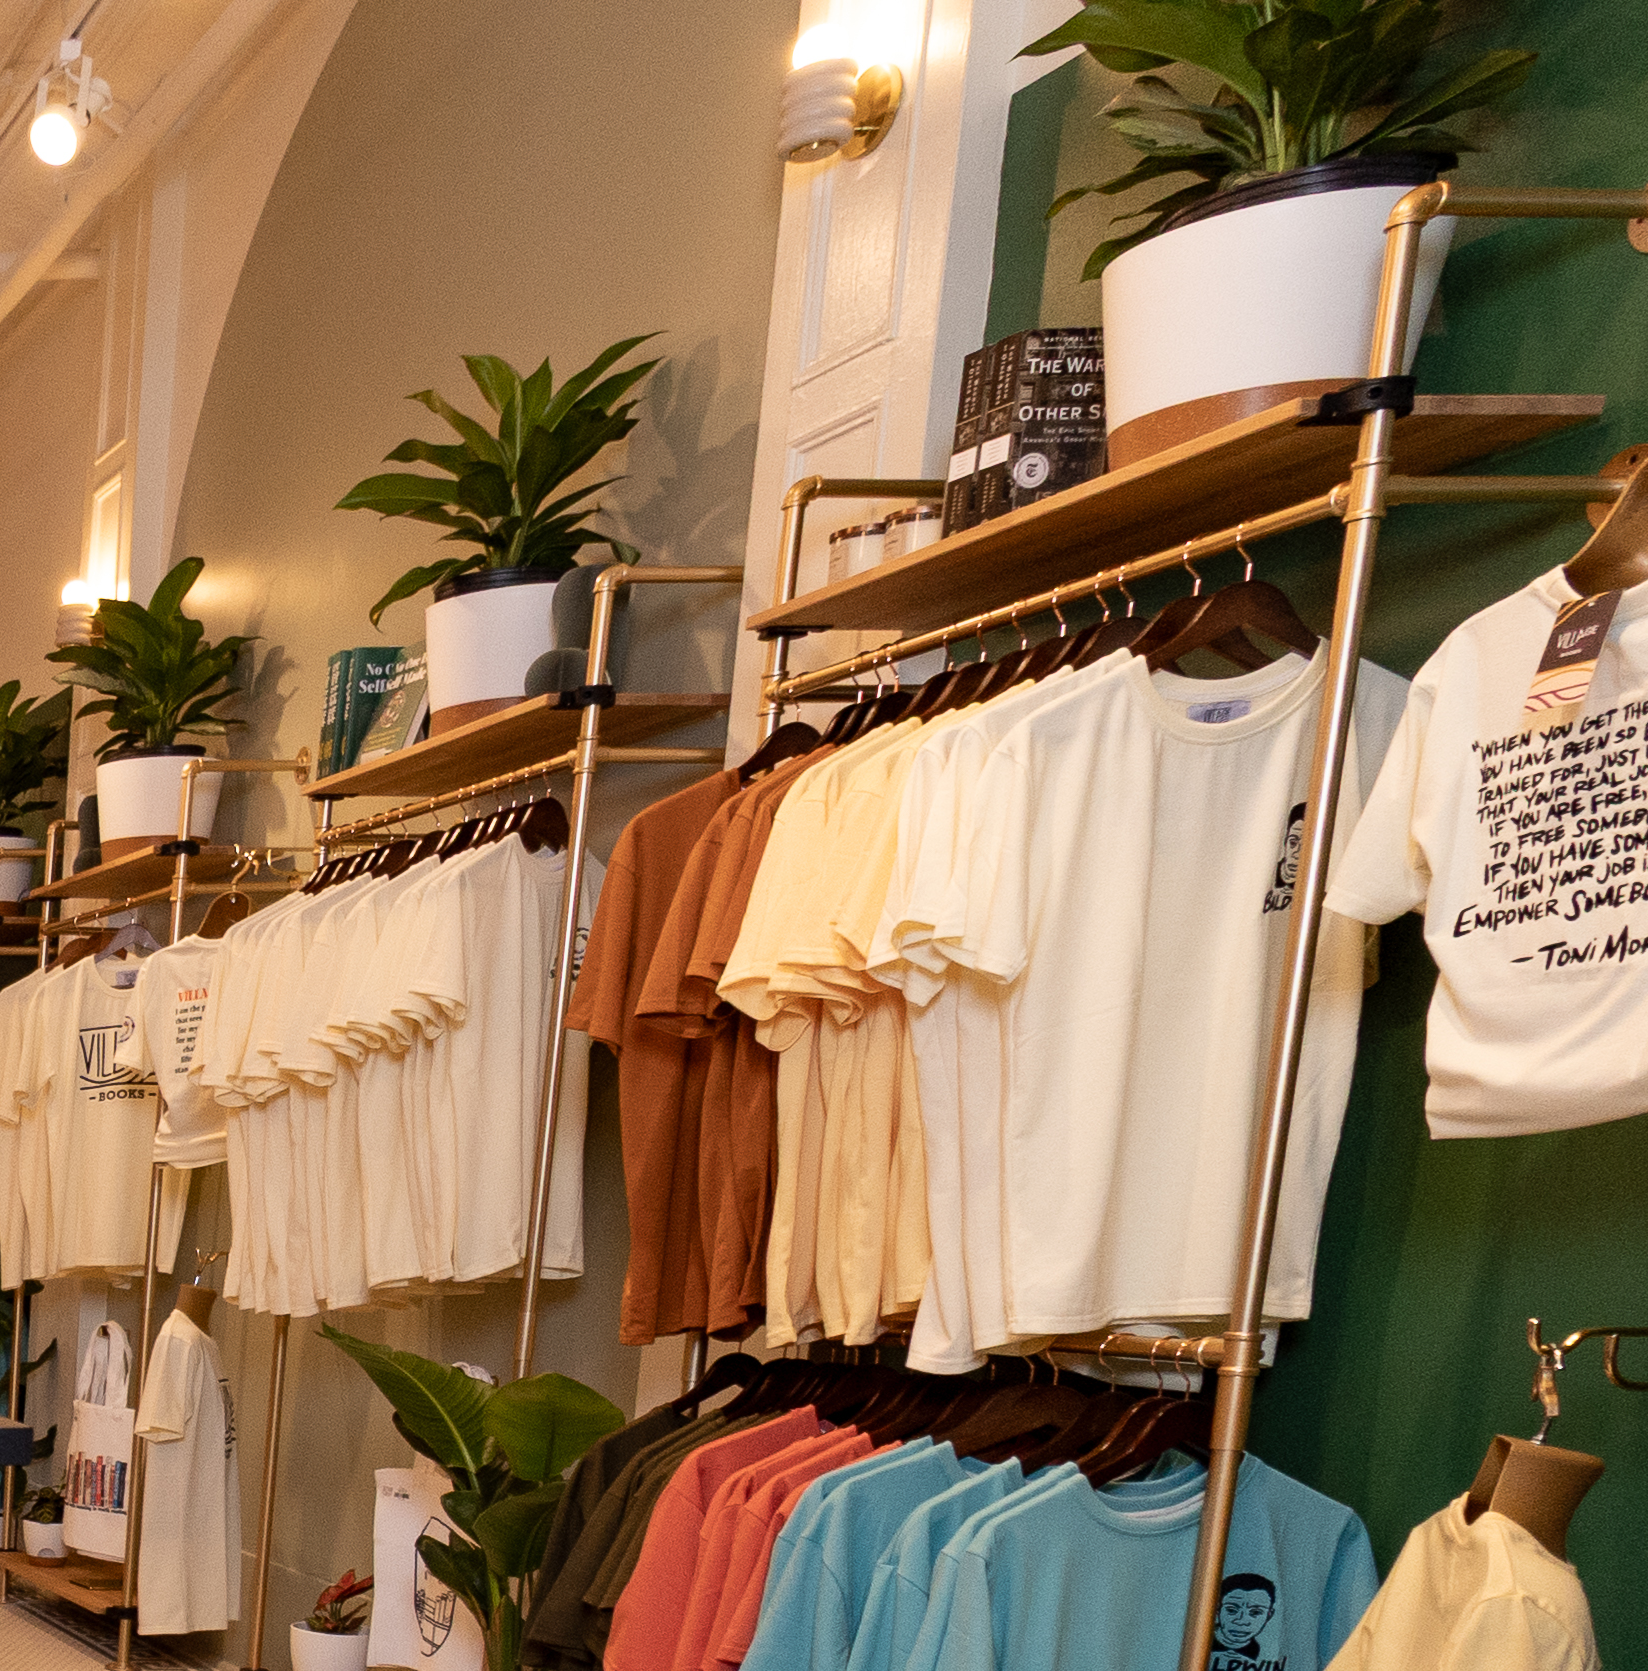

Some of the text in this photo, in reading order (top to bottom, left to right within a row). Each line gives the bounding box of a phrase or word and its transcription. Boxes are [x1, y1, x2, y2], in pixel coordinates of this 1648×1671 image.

[1027, 357, 1063, 374] THE
[1071, 383, 1095, 397] OF
[1018, 405, 1082, 422] OTHER
[1540, 708, 1616, 746] YOU GET
[1510, 739, 1605, 774] HAVE BEEN
[1478, 748, 1639, 805] TRAINED JUST
[1478, 772, 1619, 824] THAT YOUR REAL
[1546, 802, 1585, 822] ARE
[1517, 824, 1565, 851] FREE
[1510, 838, 1605, 880] YOU HAVE
[1493, 876, 1544, 904] THEN
[1453, 898, 1559, 938] EMPOWER
[98, 1089, 145, 1102] BOOKS
